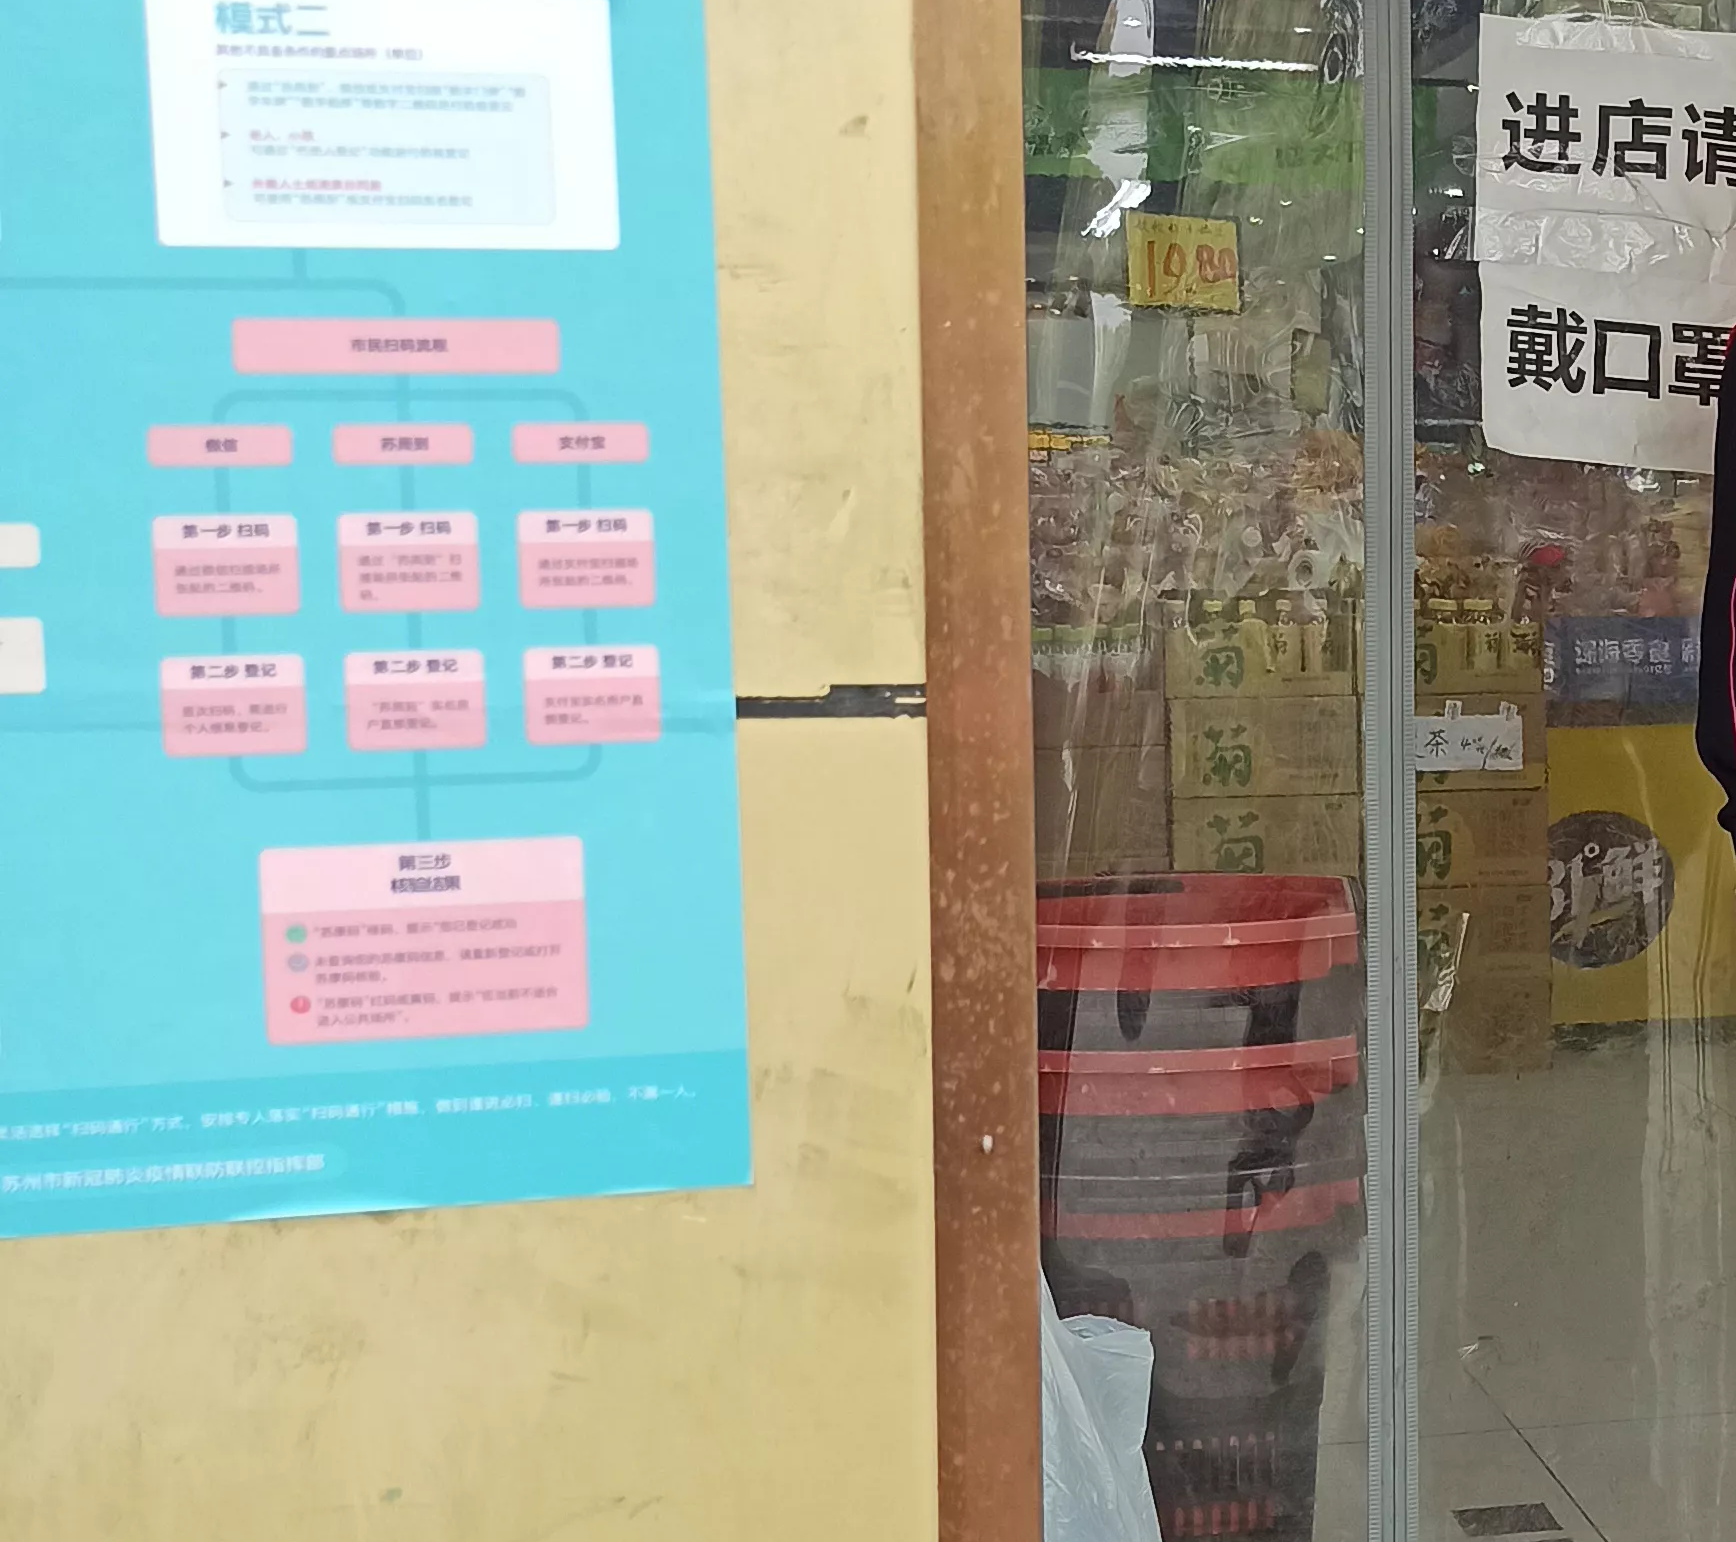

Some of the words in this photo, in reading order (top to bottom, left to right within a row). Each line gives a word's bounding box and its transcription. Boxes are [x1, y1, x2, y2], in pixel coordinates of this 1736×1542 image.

[216, 2, 331, 36] 模式二
[351, 339, 448, 353] 市民扫码流程
[1506, 304, 1732, 406] 戴口罩
[205, 438, 238, 453] 微信
[558, 435, 606, 451] 支付宝
[182, 524, 231, 539] 第一步
[237, 523, 270, 538] 扫码
[366, 521, 414, 536] 第一步
[420, 520, 452, 535] 扫码
[546, 519, 592, 533] 第一步
[597, 518, 628, 532] 扫码
[373, 660, 421, 675] 第二步
[552, 655, 598, 670] 第二步
[190, 665, 239, 680] 第二步
[244, 663, 278, 678] 登记
[398, 854, 452, 871] 第三步
